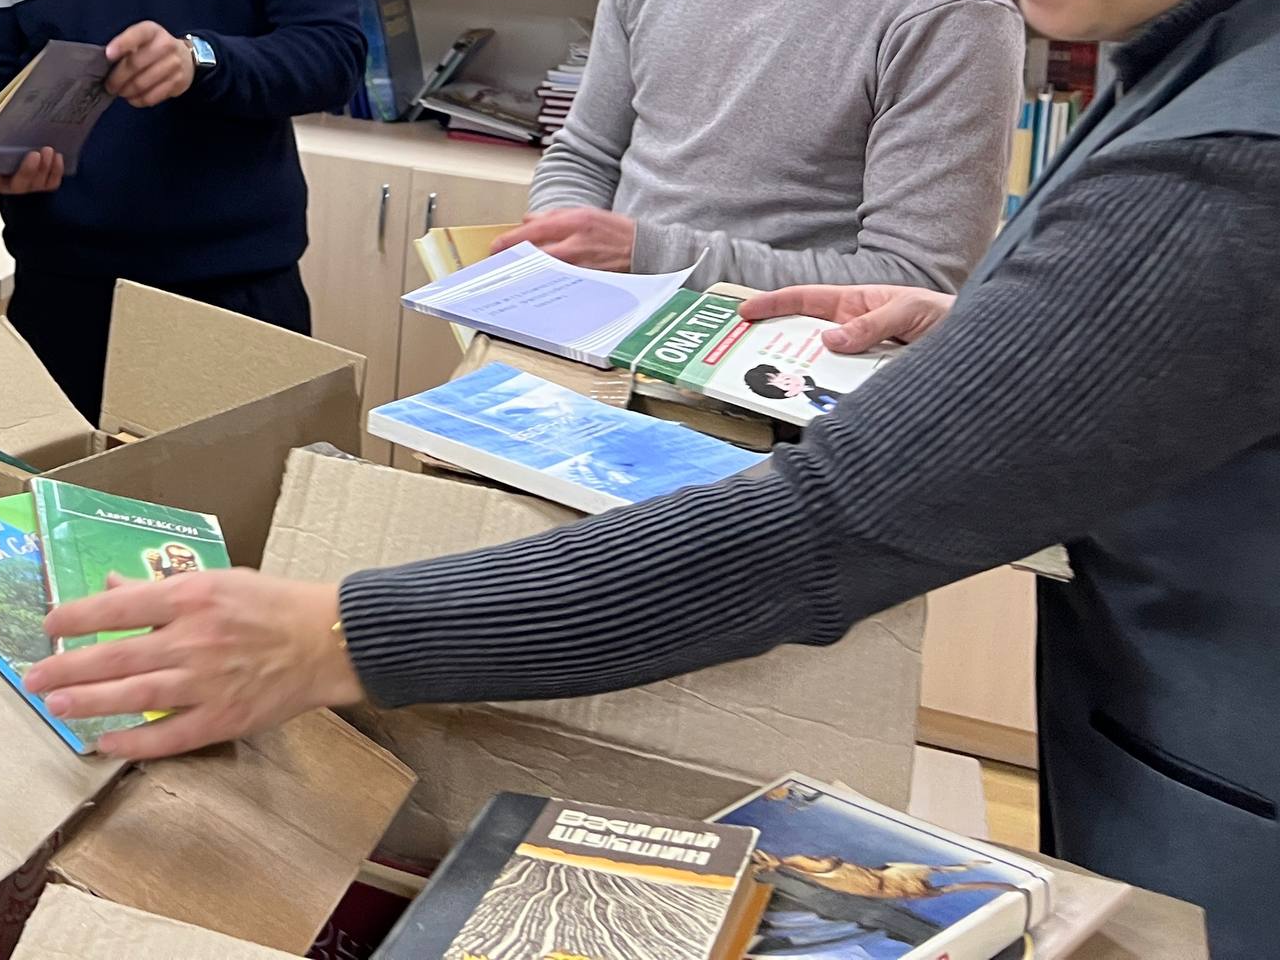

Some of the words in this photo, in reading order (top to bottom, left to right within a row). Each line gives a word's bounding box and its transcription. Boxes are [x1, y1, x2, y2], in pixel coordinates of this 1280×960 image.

[655, 330, 705, 364] ONA
[686, 303, 736, 330] TILI
[131, 515, 199, 536] ЖЕКСОН
